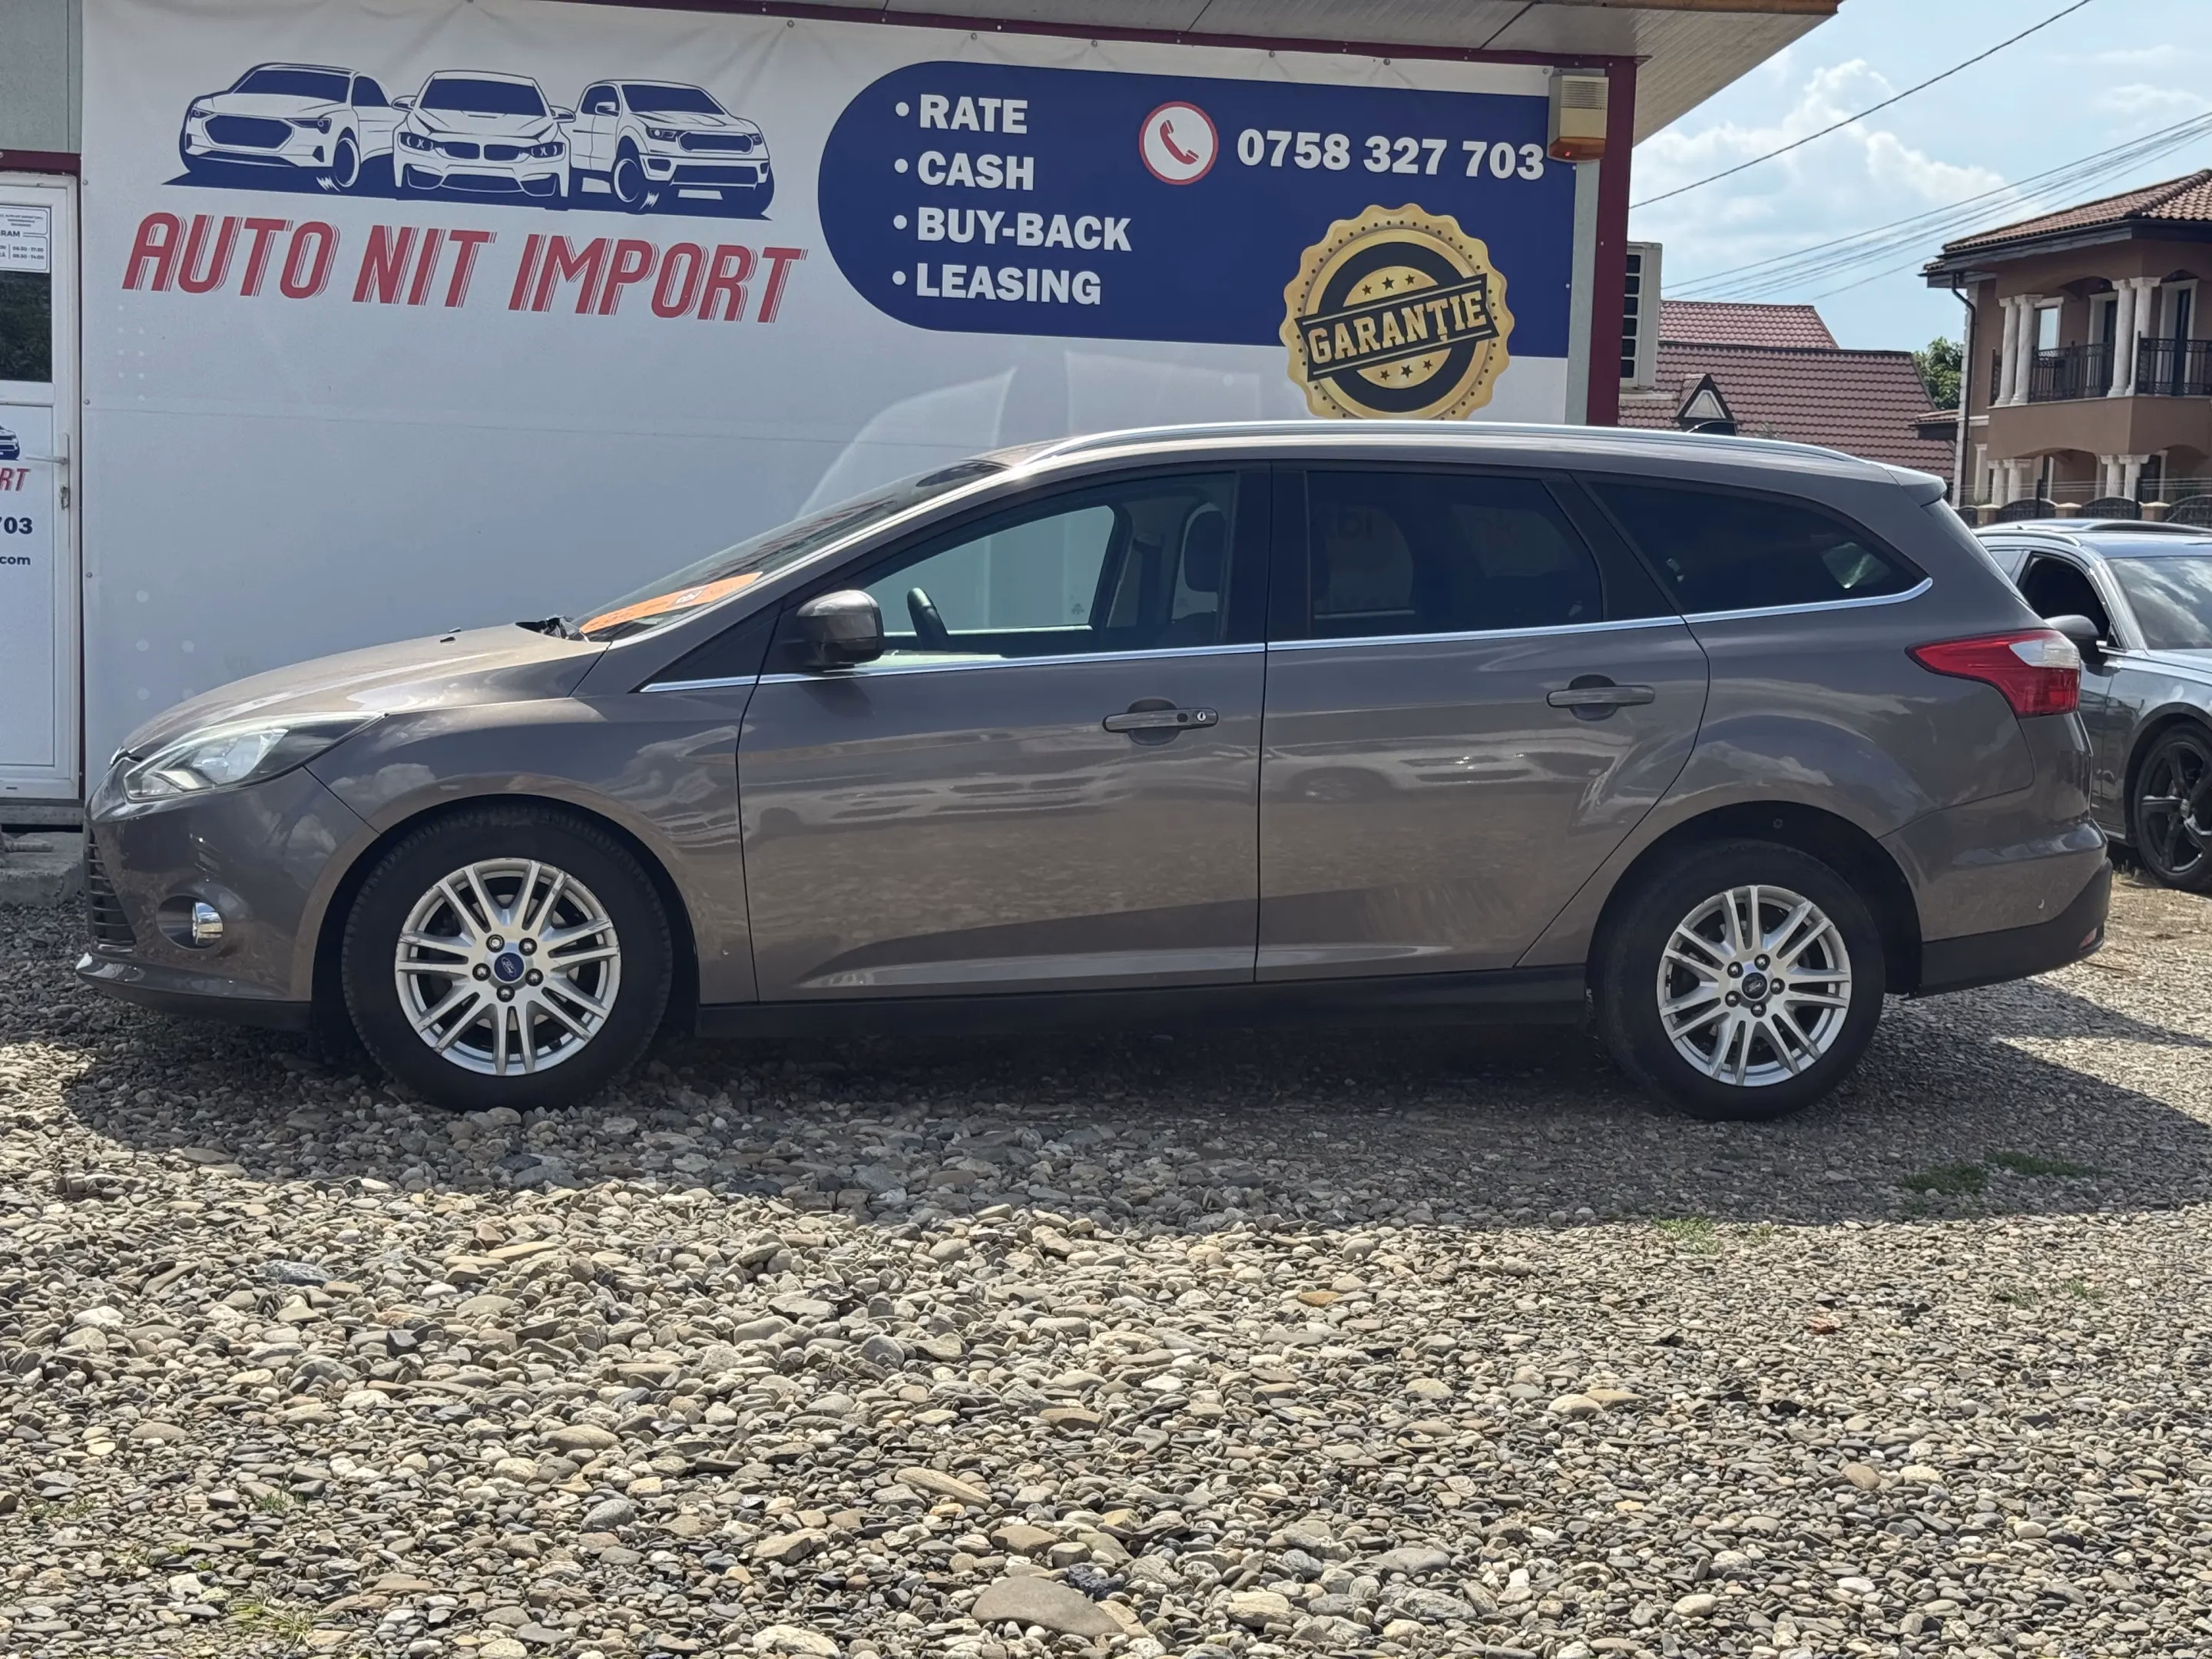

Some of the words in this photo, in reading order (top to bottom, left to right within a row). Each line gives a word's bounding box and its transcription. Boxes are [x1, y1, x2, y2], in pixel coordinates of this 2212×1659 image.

[919, 93, 1028, 135] RATE
[917, 151, 1035, 192] CASH
[1237, 128, 1351, 171] 0758
[1363, 135, 1447, 176] 327
[1462, 141, 1545, 181] 703
[917, 207, 1132, 252] BUY-BACK
[122, 212, 340, 299] AUTO
[353, 225, 496, 309] NIT
[508, 233, 808, 323] IMPORT
[916, 262, 1101, 306] LEASING
[0, 516, 33, 535] 03
